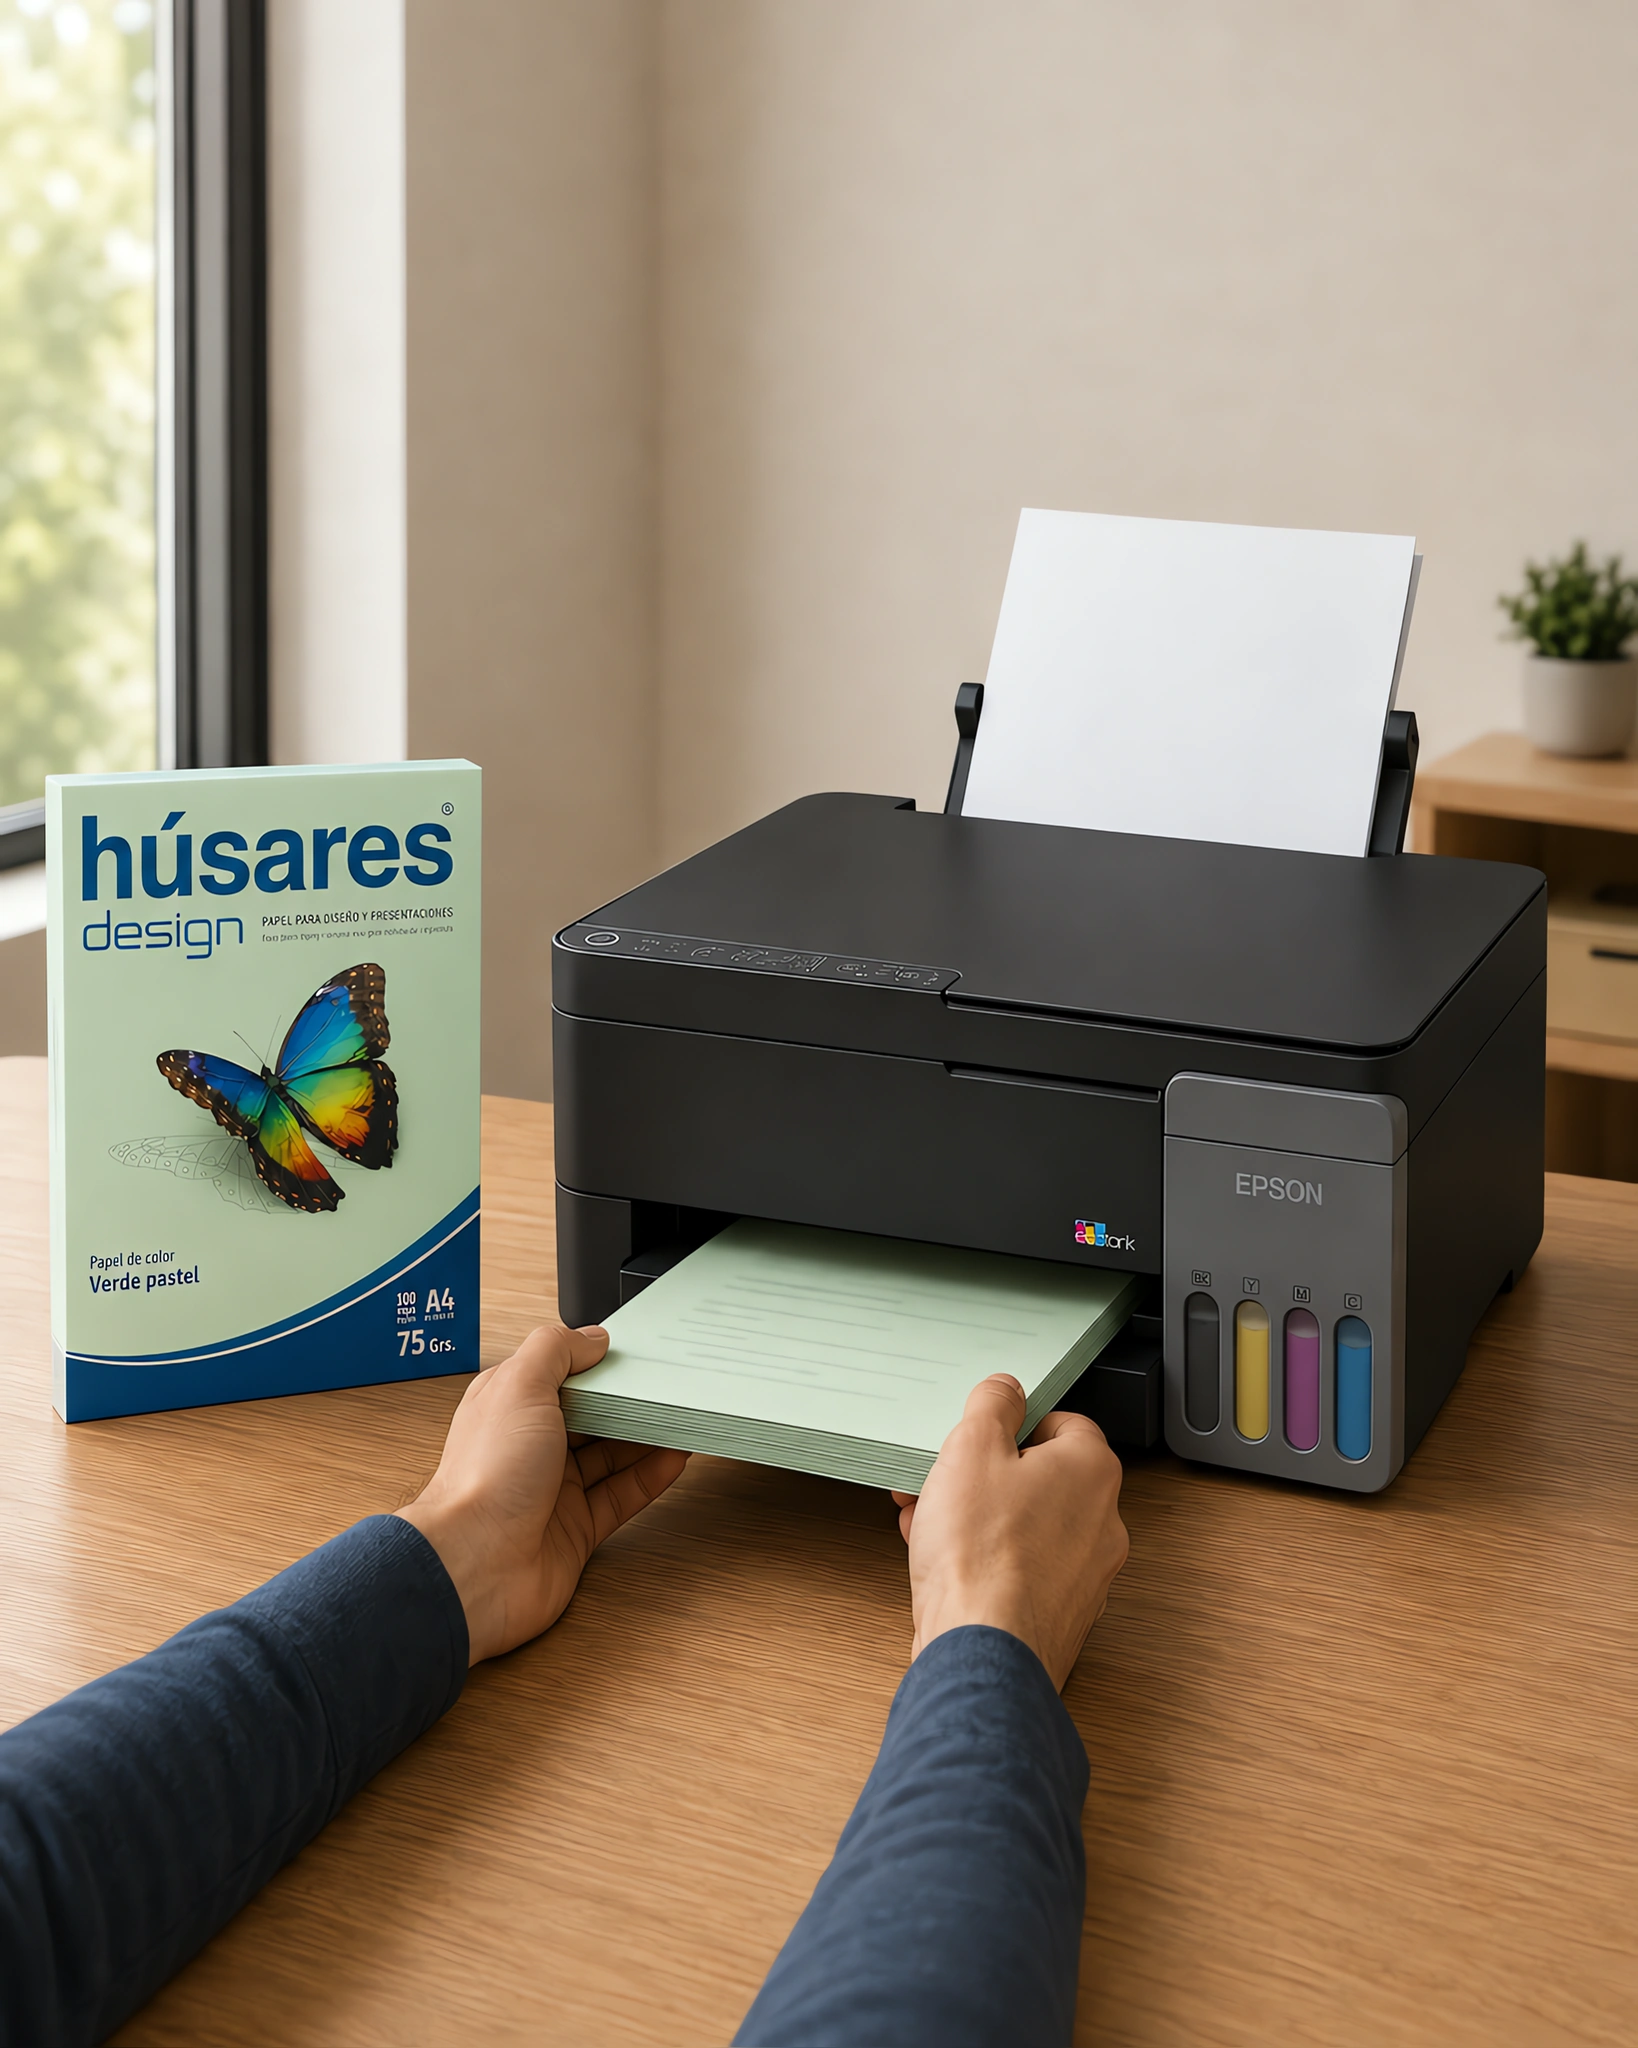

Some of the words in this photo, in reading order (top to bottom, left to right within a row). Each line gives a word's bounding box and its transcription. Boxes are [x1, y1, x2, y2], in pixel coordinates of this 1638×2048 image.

[82, 811, 454, 901] húsares
[262, 915, 292, 927] PAPEL
[295, 913, 321, 925] PARA
[361, 911, 368, 921] Y
[82, 910, 244, 960] design
[1236, 1172, 1322, 1206] EPSON
[90, 1253, 123, 1271] Papel
[127, 1252, 142, 1266] de
[145, 1249, 175, 1264] color
[89, 1272, 141, 1293] Verde
[146, 1265, 200, 1293] pastel
[396, 1291, 417, 1307] 100
[425, 1287, 456, 1313] A4
[397, 1329, 426, 1357] 75
[429, 1337, 456, 1353] Grs.
